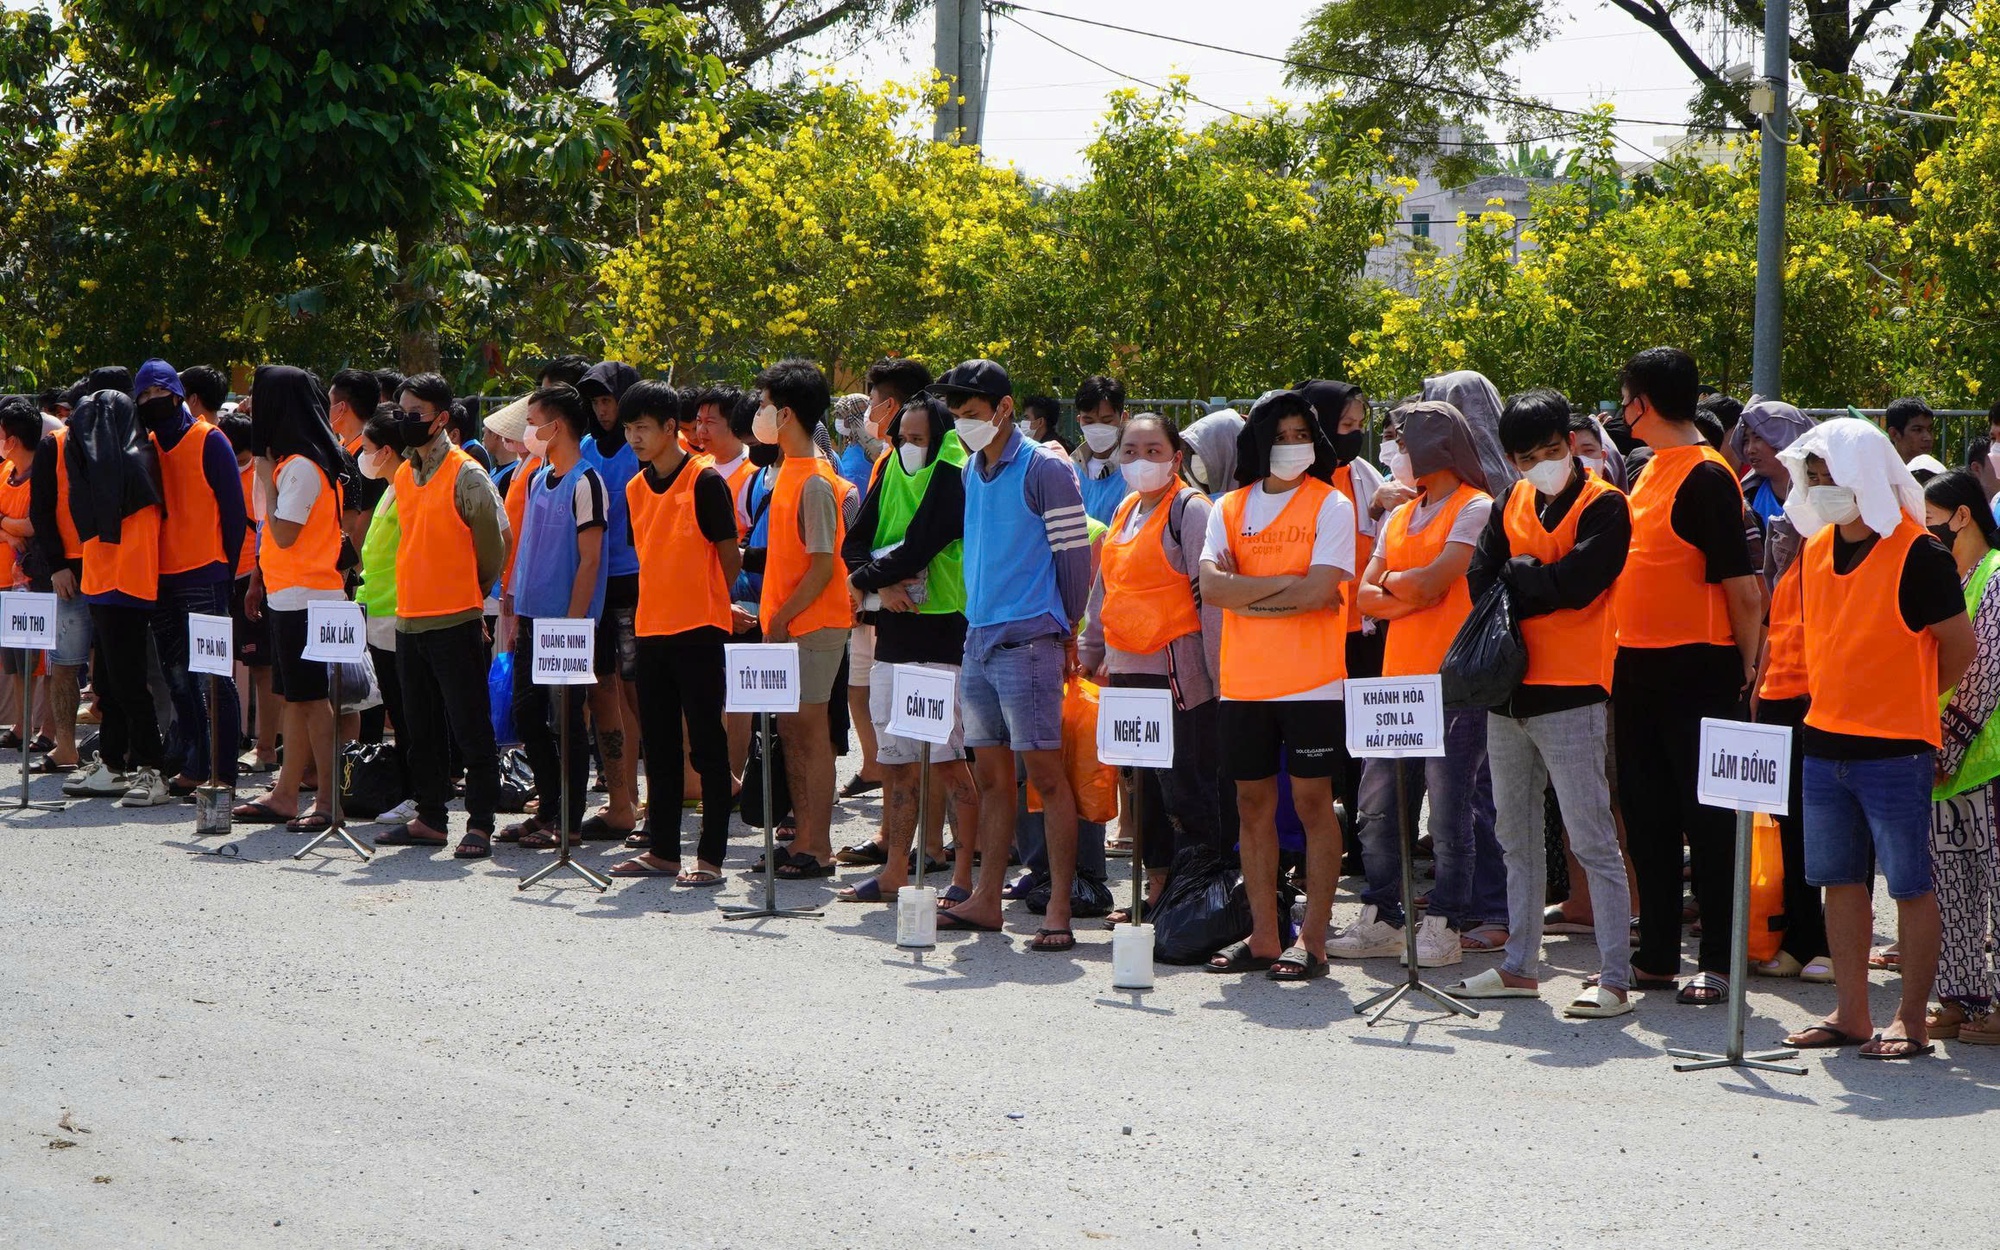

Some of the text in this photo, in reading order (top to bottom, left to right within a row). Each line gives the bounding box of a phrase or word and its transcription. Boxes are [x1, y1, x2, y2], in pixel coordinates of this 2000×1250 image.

[12, 611, 45, 636] PHÚ THỌ
[197, 635, 227, 661] TP HÀ NỘI
[540, 628, 586, 649] QUẢNG NINH
[538, 654, 588, 673] TUYÊN QUANG
[739, 665, 787, 690] TÂY NINH
[906, 689, 945, 721] CẦN THƠ
[1363, 686, 1425, 706] KHÁNH HÒA
[1114, 715, 1160, 748] NGHỆ AN
[1375, 711, 1415, 727] SƠN LA
[1366, 728, 1424, 748] HẢI PHÒNG
[1711, 748, 1777, 785] LÂM ĐỒNG
